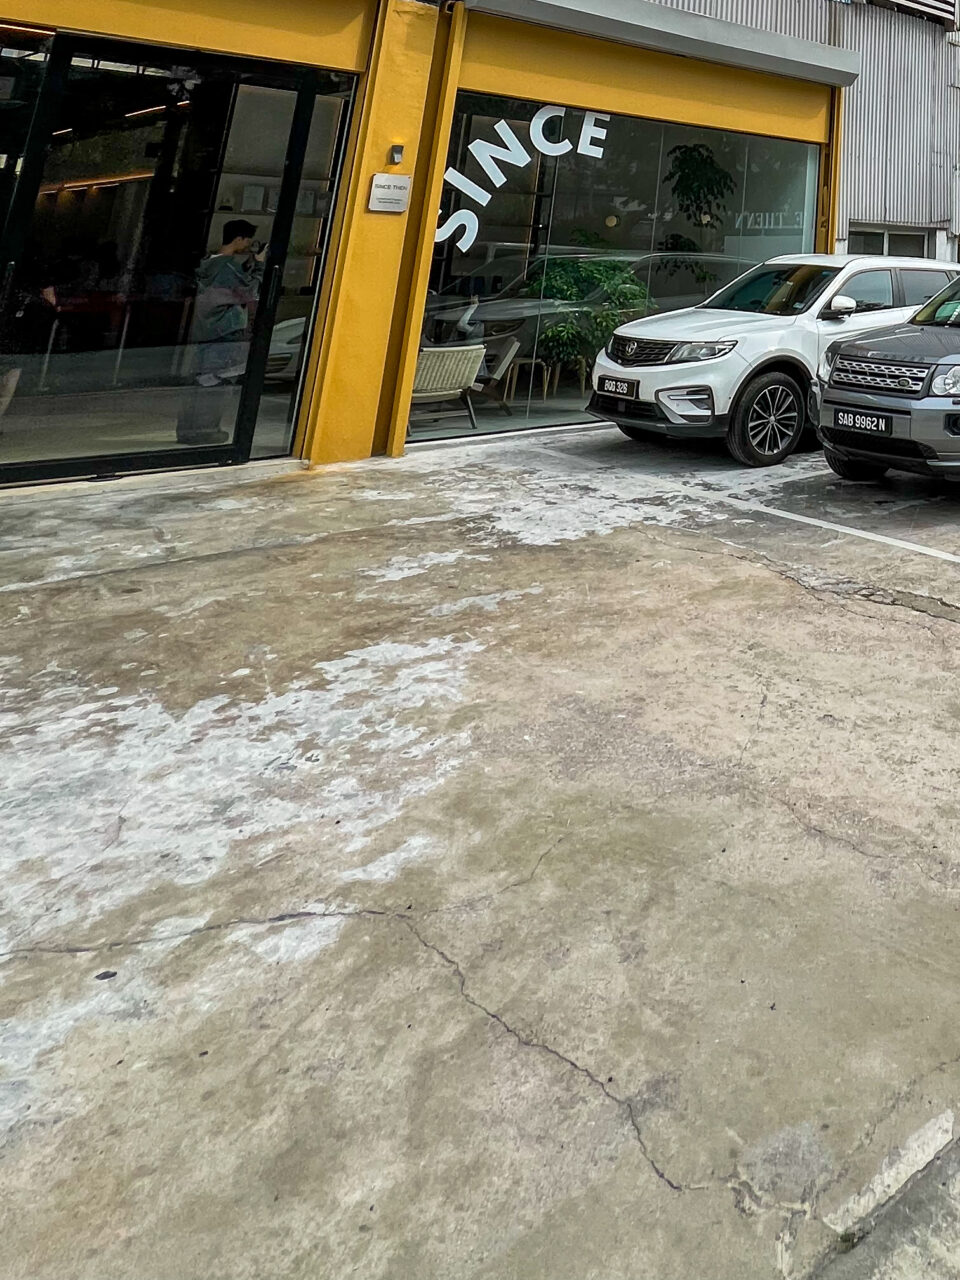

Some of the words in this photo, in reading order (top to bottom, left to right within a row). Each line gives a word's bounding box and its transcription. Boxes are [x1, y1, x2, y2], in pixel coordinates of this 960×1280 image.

[434, 104, 611, 253] SINCE
[838, 412, 854, 427] SAB
[855, 414, 877, 430] 9962
[878, 418, 886, 431] N
